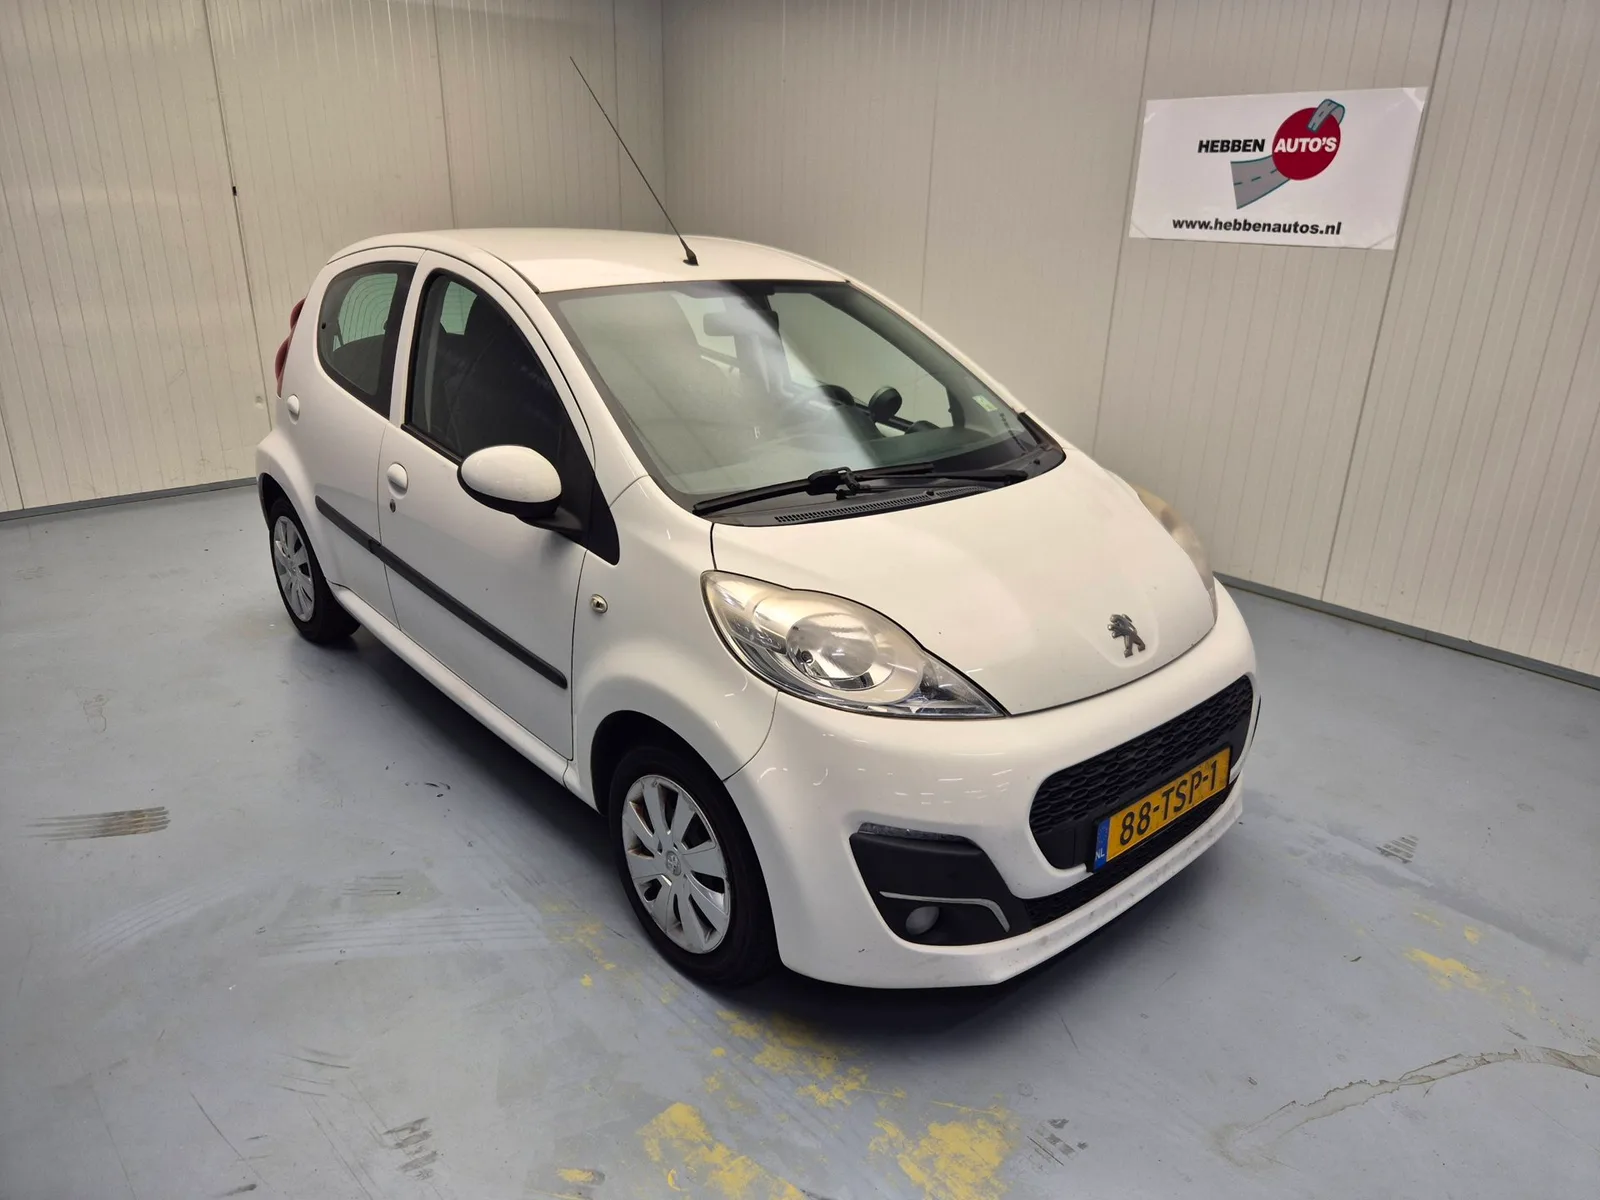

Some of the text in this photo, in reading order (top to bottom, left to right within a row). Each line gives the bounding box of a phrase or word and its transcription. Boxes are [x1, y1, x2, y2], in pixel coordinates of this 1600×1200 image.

[1197, 136, 1338, 154] HEBBEN AUTO'S
[1171, 218, 1343, 236] www.hebbenautos.nl
[1119, 760, 1218, 846] 88-TSP-1
[1095, 848, 1106, 860] NL
